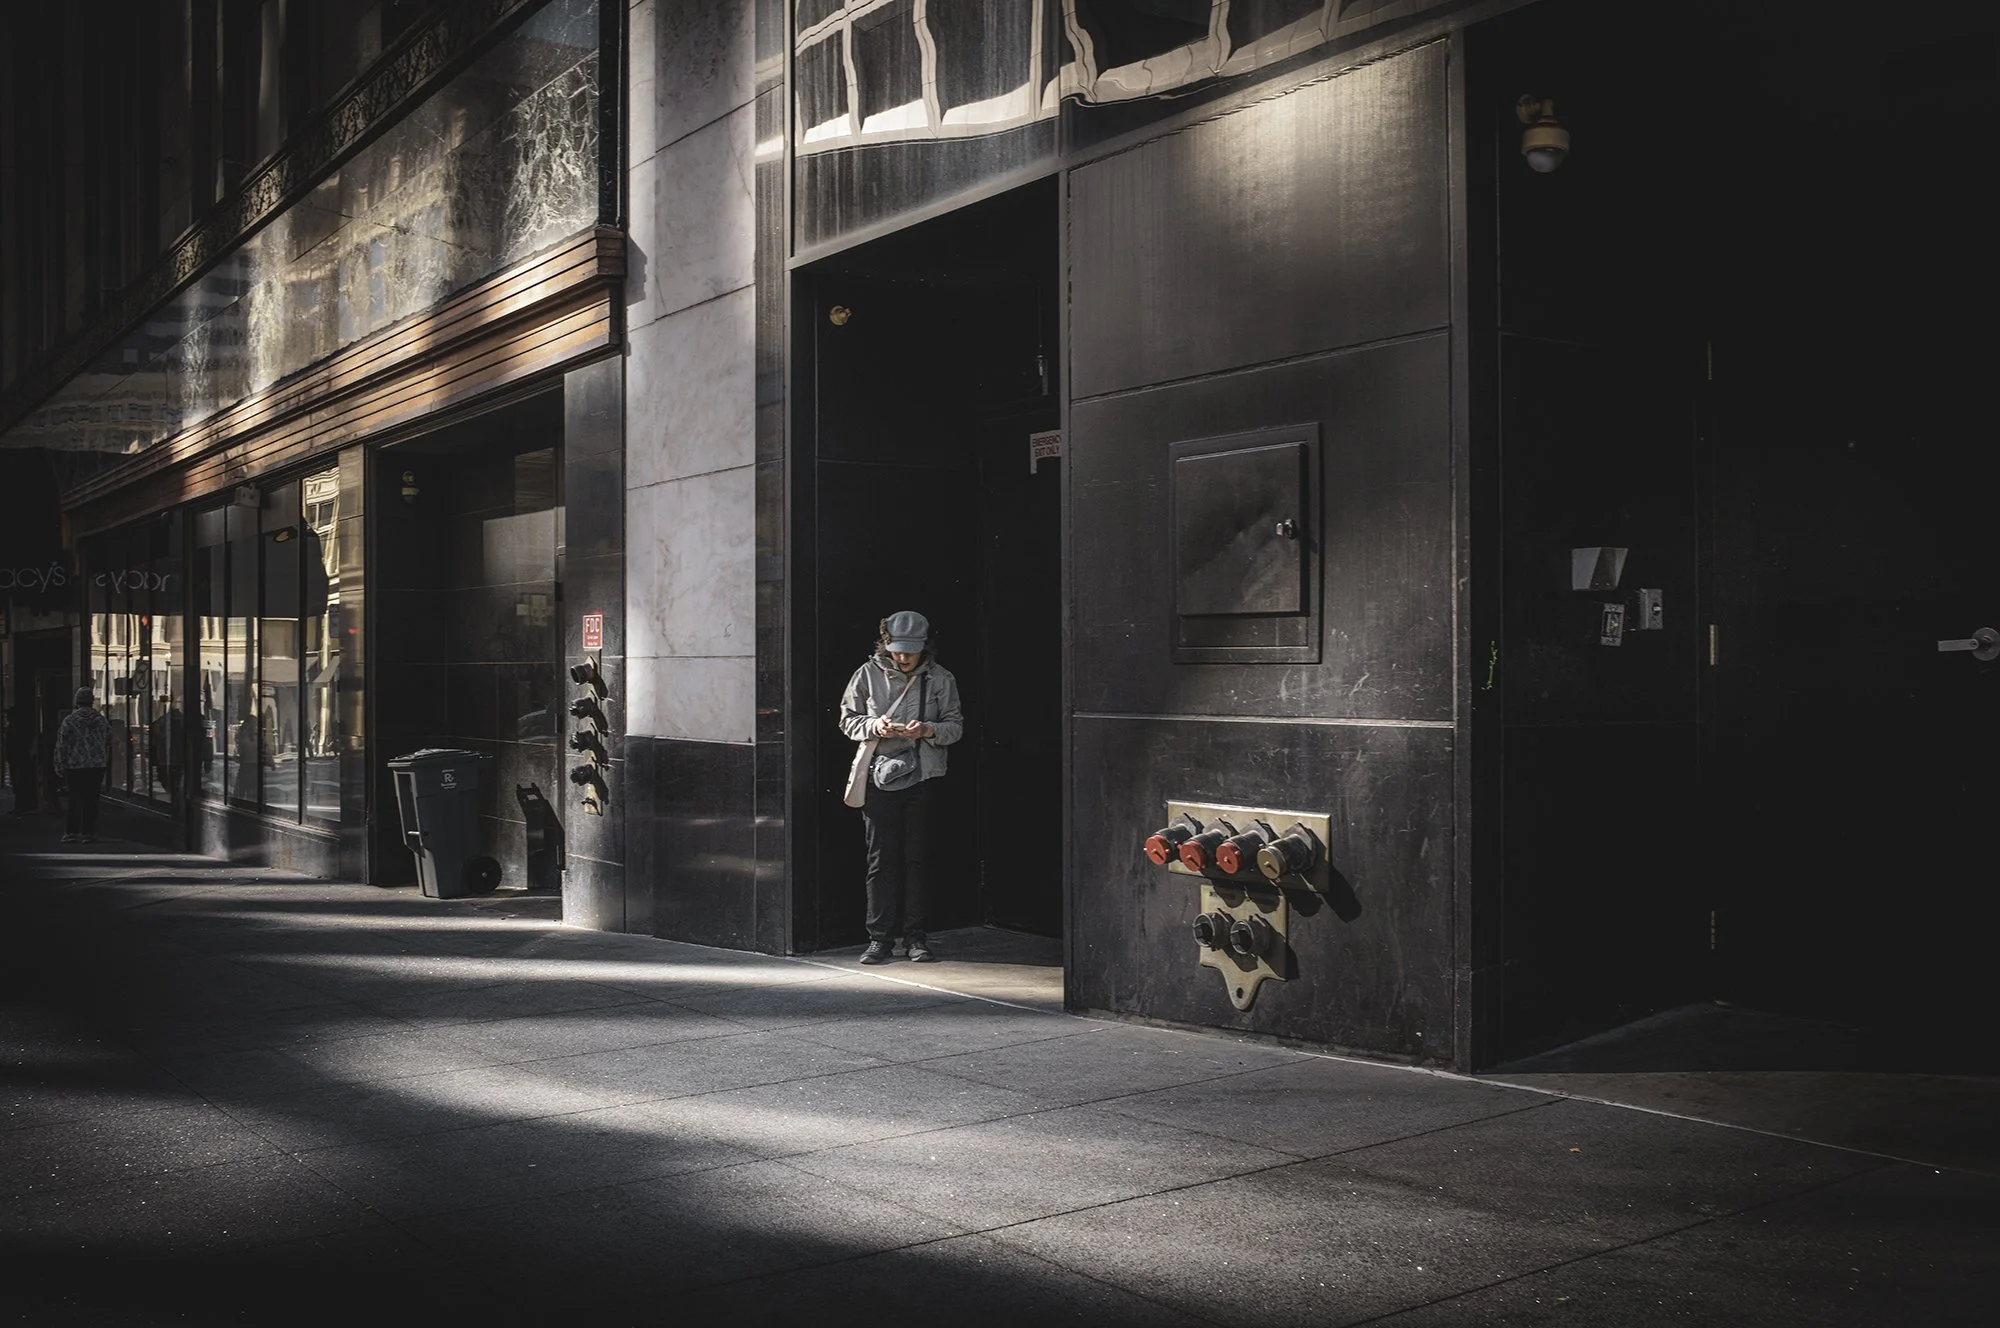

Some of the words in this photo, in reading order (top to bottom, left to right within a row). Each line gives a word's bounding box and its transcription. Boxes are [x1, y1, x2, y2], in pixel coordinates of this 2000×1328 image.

[1035, 446, 1046, 458] EXIT
[1046, 445, 1060, 456] ONLY
[585, 617, 600, 633] FDC
